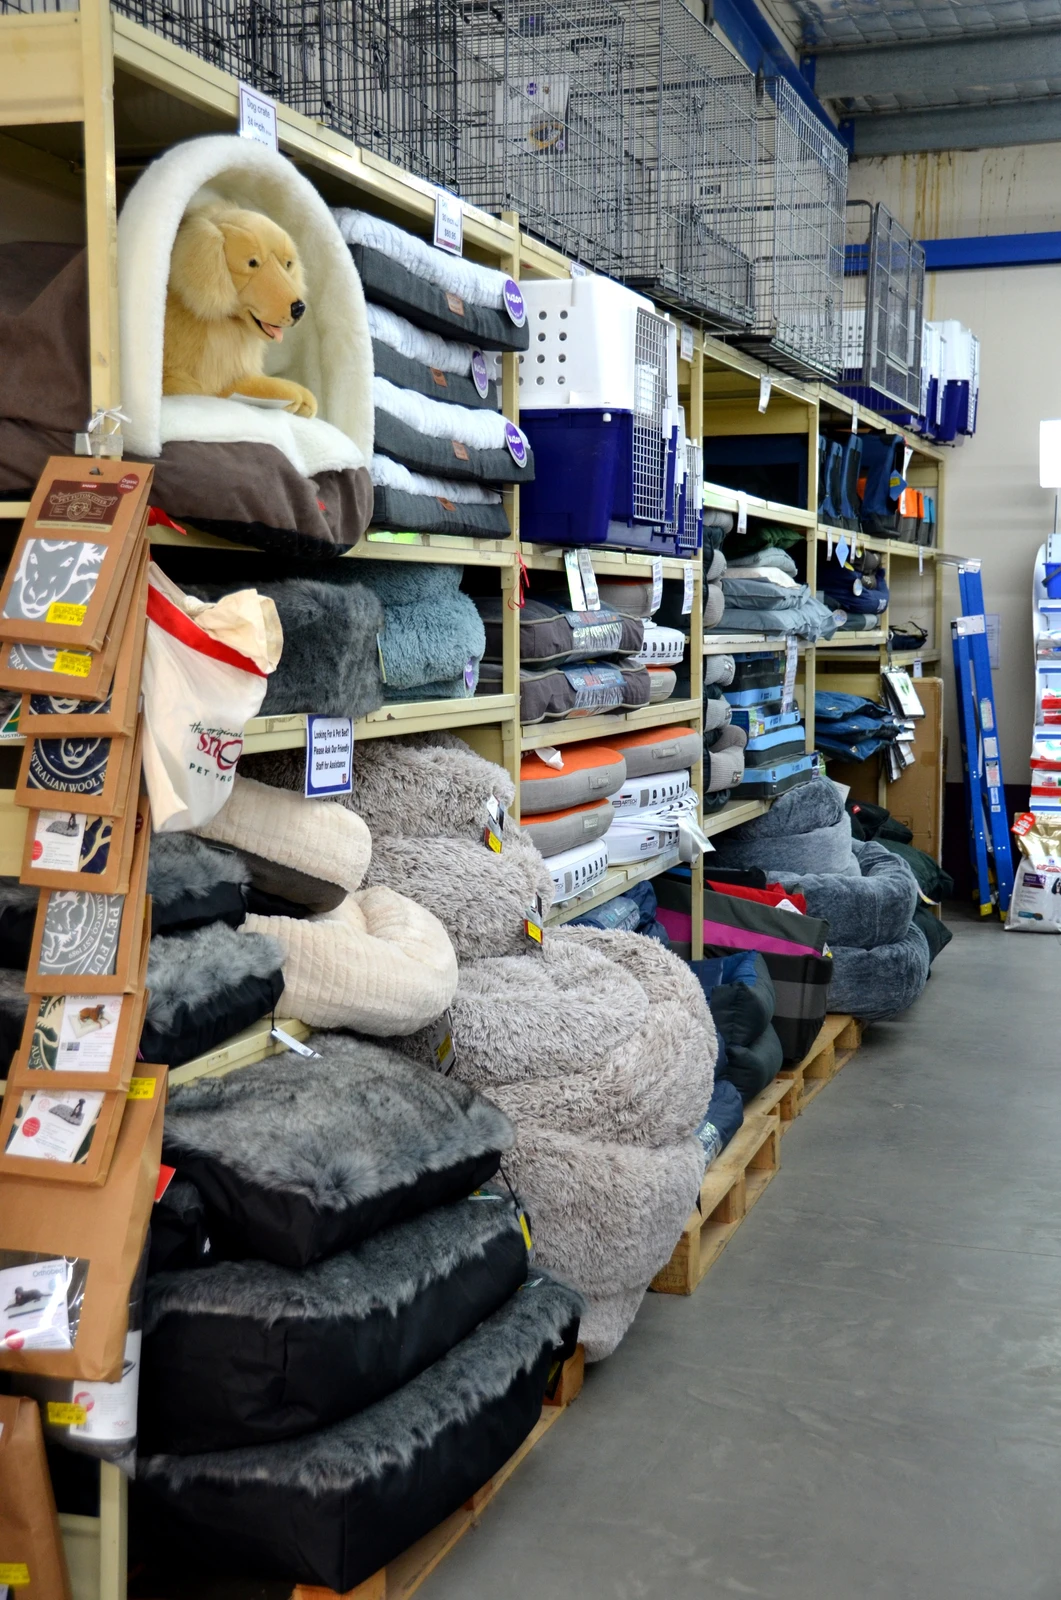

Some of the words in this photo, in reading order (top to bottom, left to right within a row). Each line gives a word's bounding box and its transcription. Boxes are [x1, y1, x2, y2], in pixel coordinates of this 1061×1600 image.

[247, 97, 257, 113] Dog
[257, 105, 271, 119] crate
[248, 116, 254, 126] 24
[253, 119, 266, 133] inch
[189, 721, 204, 735] the
[206, 727, 243, 741] original
[314, 730, 327, 740] Looking
[341, 728, 349, 738] Bed?
[314, 746, 325, 755] Please
[338, 744, 349, 754] Friendly
[189, 762, 210, 776] PET
[330, 760, 346, 769] Assistance
[68, 776, 100, 793] WOOL
[104, 906, 120, 943] PET
[32, 1267, 65, 1278] Orthobed
